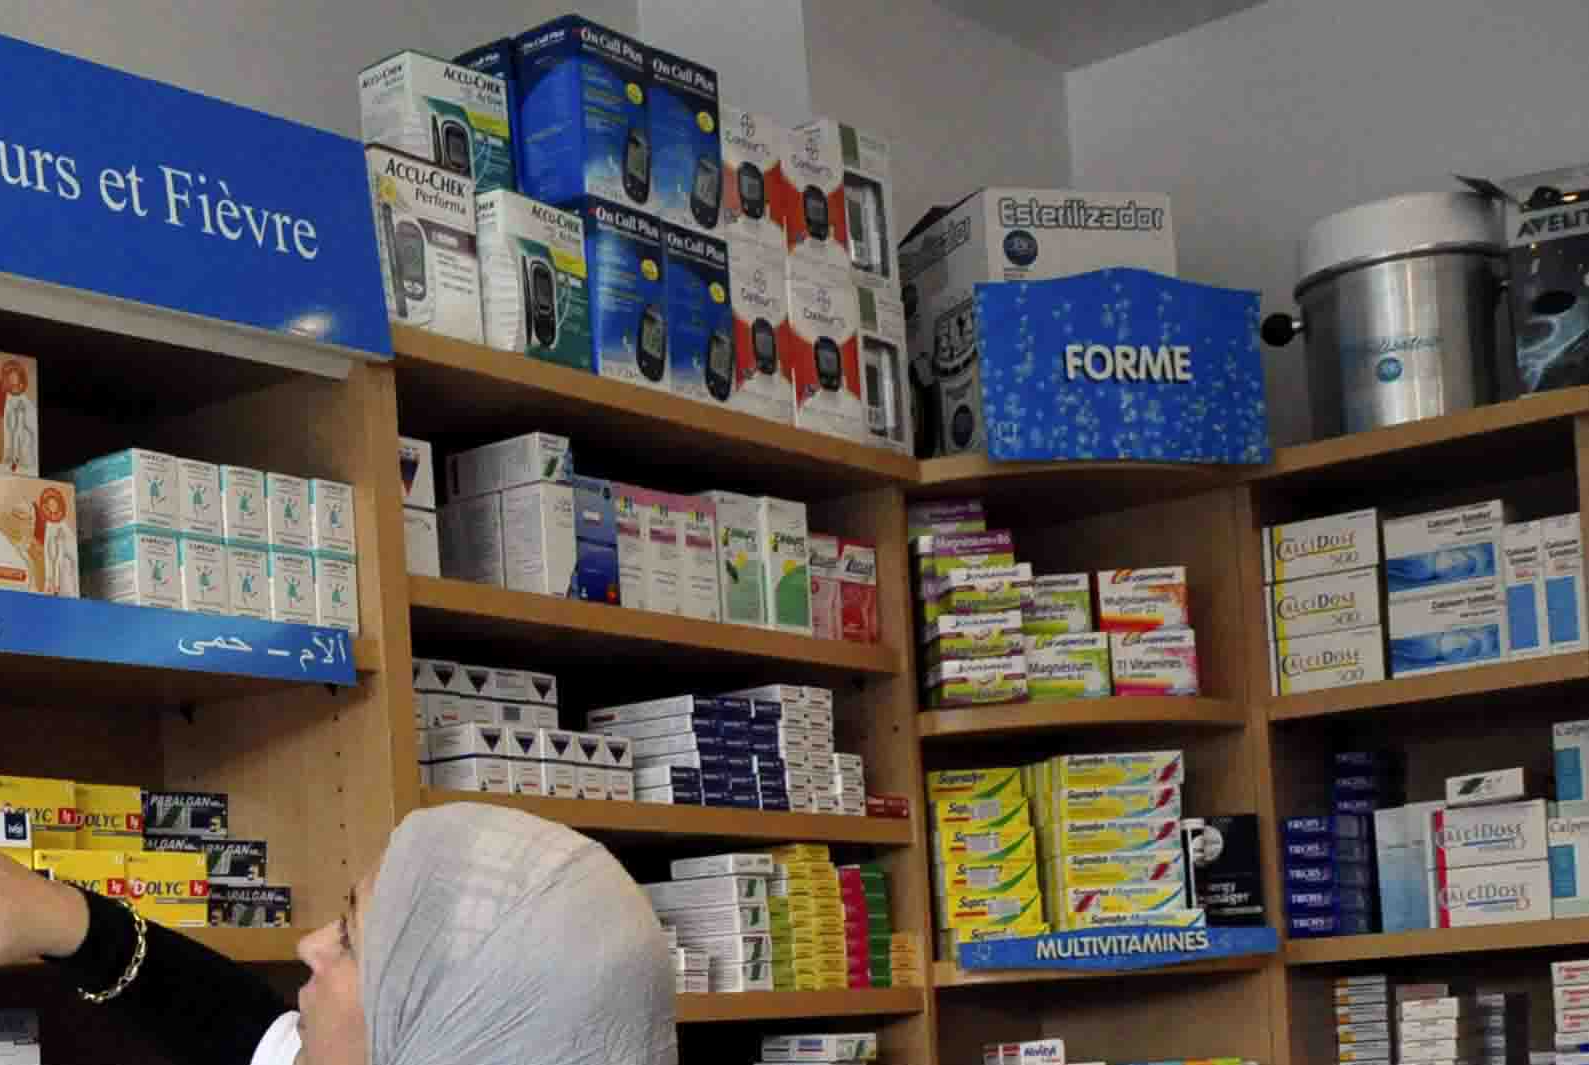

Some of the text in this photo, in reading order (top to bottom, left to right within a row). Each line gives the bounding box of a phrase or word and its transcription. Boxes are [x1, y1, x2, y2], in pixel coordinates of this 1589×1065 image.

[443, 66, 502, 95] ACCU-CHEK
[384, 157, 467, 199] ACCU-CHEK
[99, 167, 149, 217] et
[163, 165, 318, 259] Fièvre
[414, 187, 467, 215] Performa
[999, 198, 1164, 231] Esterilizador
[1064, 344, 1193, 385] FORME
[1036, 930, 1211, 961] MULTIVITAMINES
